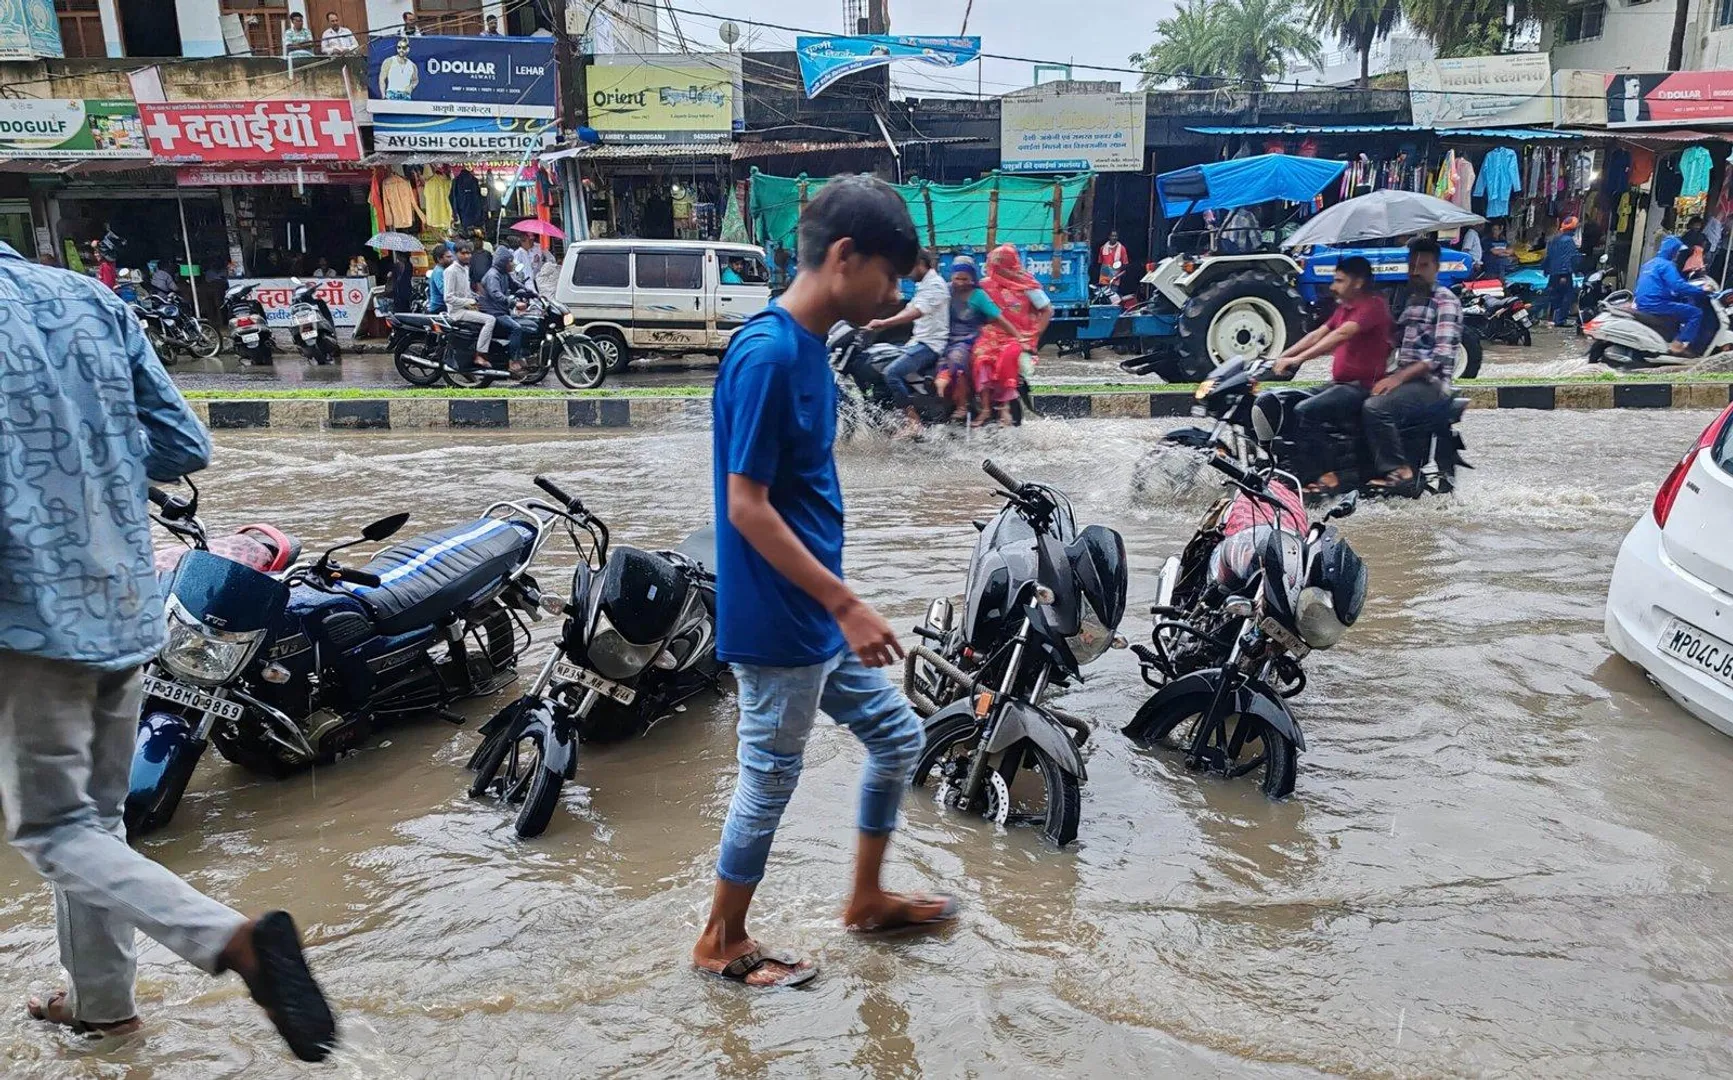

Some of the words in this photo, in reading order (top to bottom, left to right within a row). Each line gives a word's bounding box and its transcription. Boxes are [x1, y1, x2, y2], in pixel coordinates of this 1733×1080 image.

[441, 61, 495, 74] DOLLAR
[515, 66, 544, 75] LEHAR
[593, 88, 647, 107] Orient
[1667, 90, 1701, 98] DOLLAR
[388, 136, 443, 148] AYUSHI
[448, 137, 543, 149] COLLECTION
[1669, 629, 1733, 680] MP04CJ6
